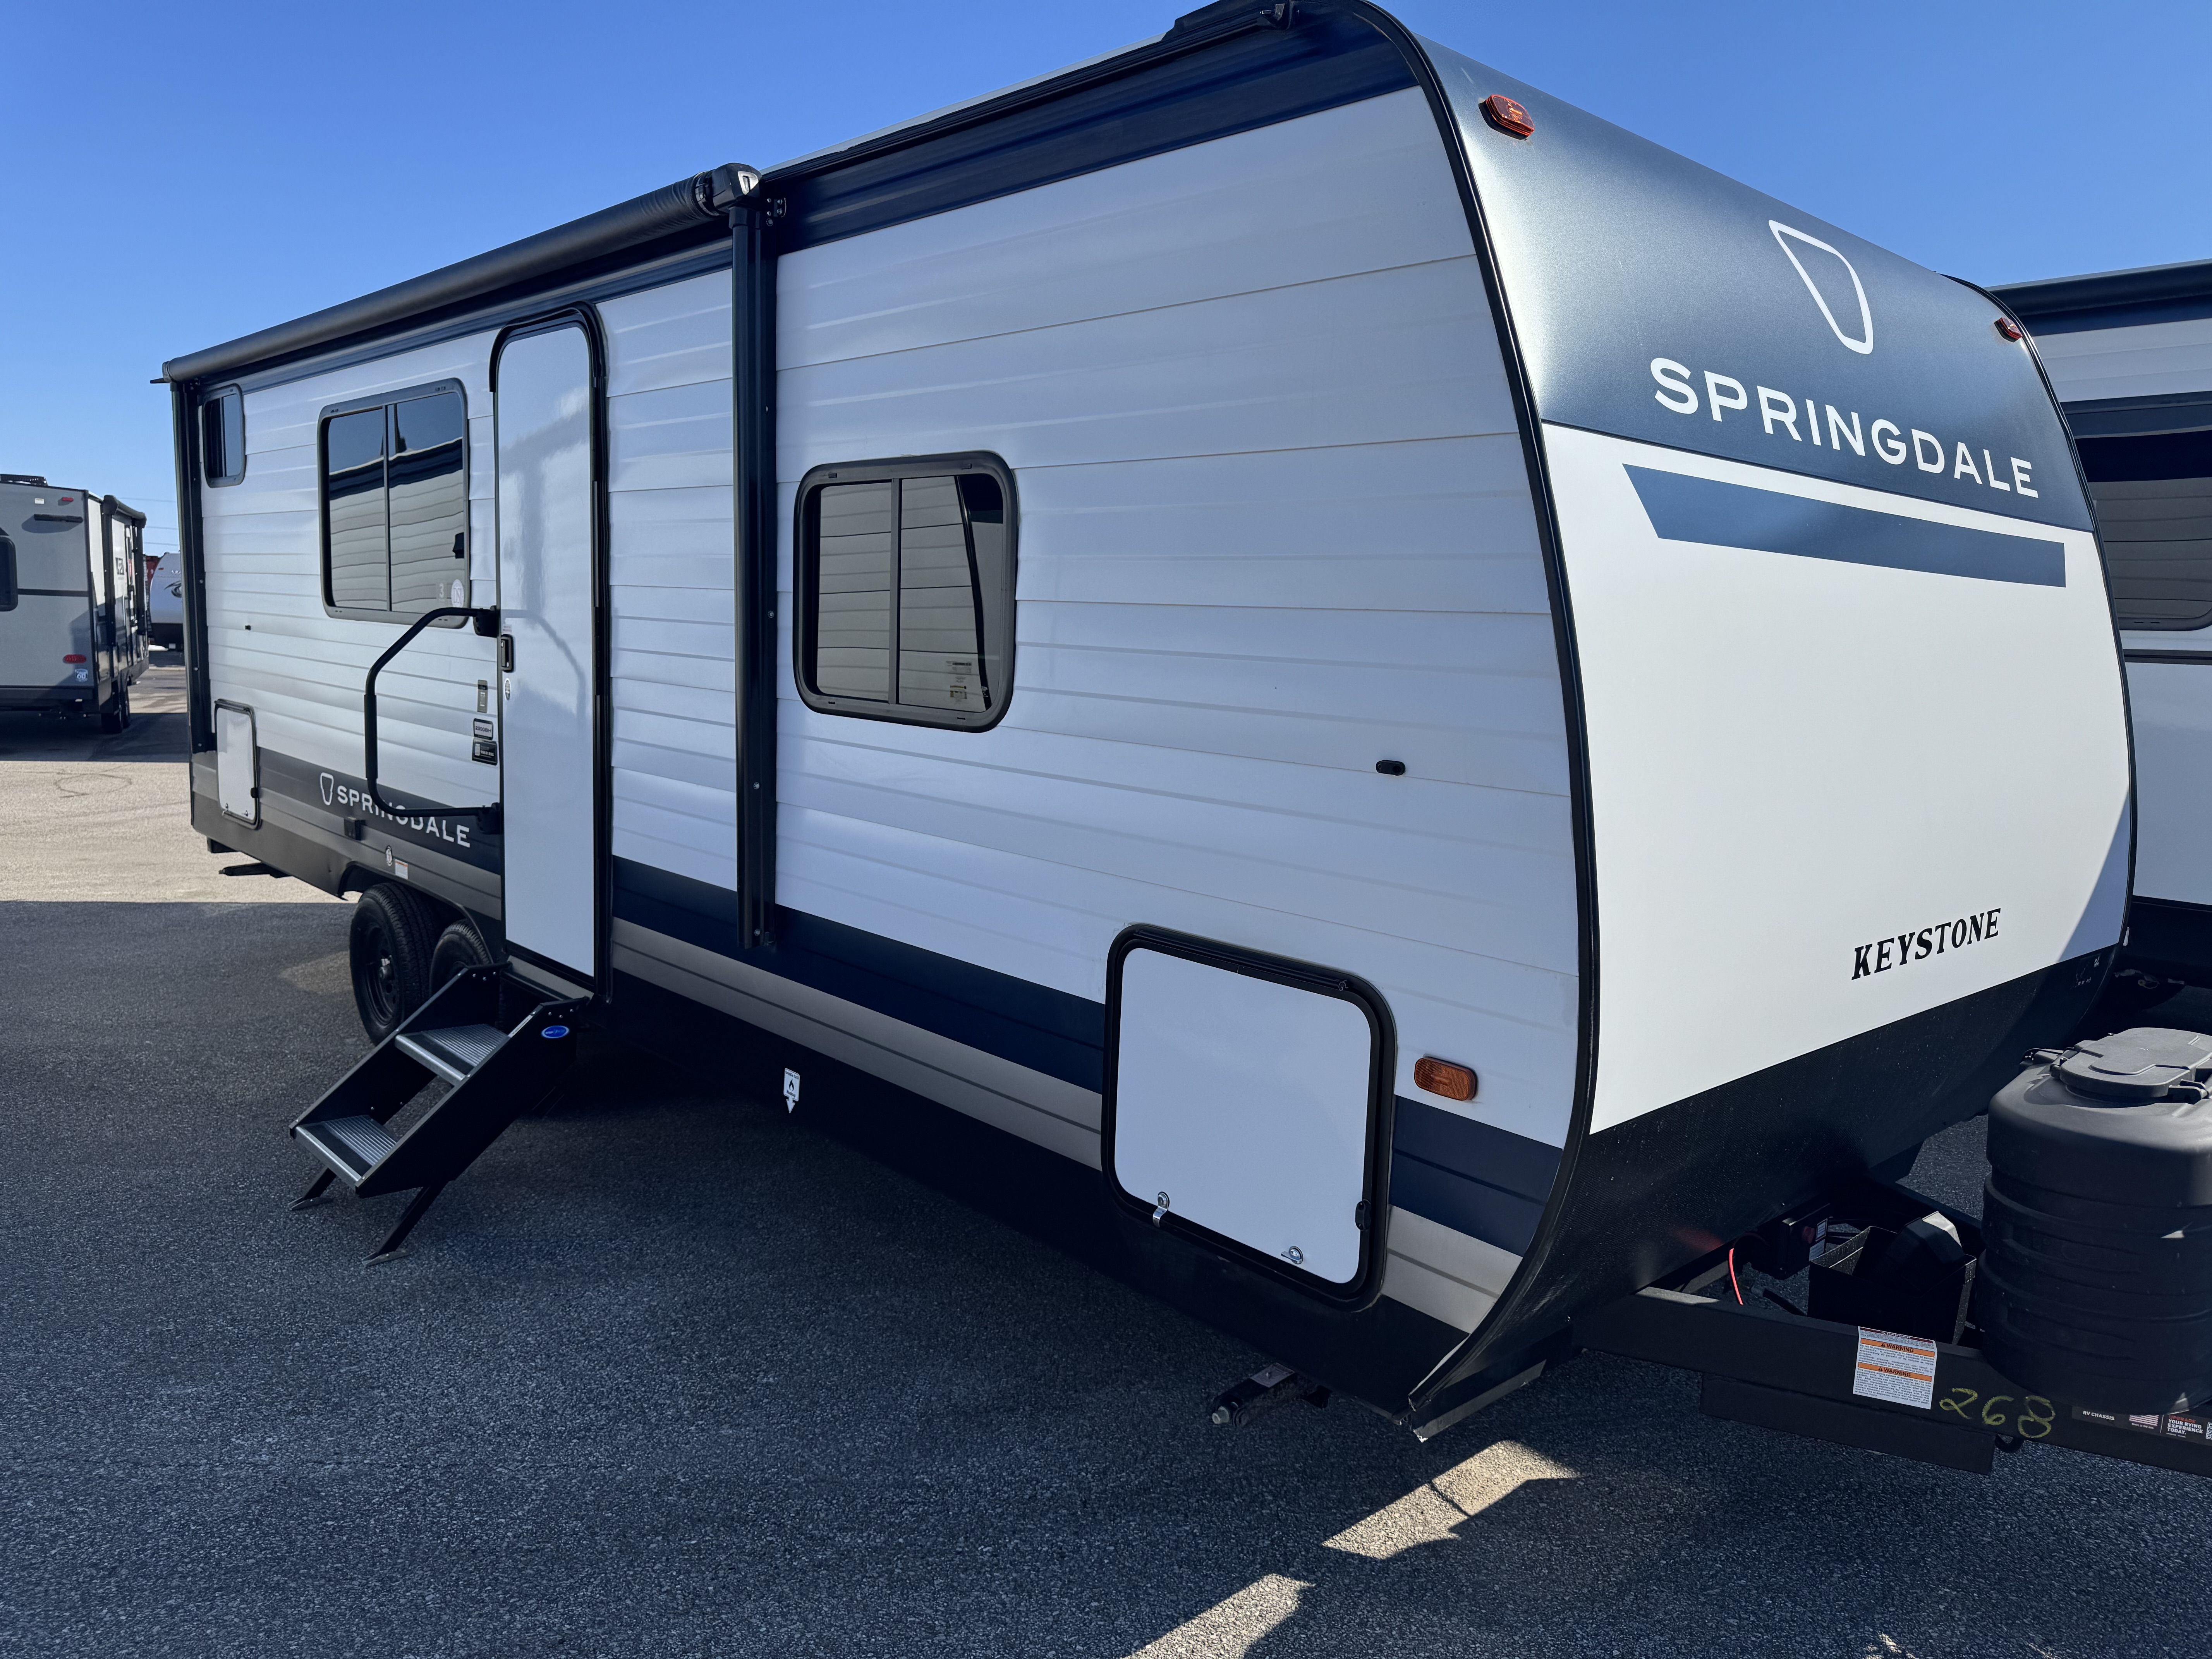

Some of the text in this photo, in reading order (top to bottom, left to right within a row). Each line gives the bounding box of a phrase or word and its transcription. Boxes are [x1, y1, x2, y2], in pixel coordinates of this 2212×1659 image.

[1650, 357, 2038, 499] SPRINGDALE
[1851, 908, 2001, 980] KEYSTONE
[1887, 1343, 1914, 1353] WARNING
[1884, 1368, 1911, 1377] WARNING
[1939, 1388, 2056, 1438] 268
[2091, 1412, 2115, 1420] CHASSIS
[2169, 1415, 2197, 1424] UPGRADE
[2167, 1423, 2203, 1434] EXPERIENCE
